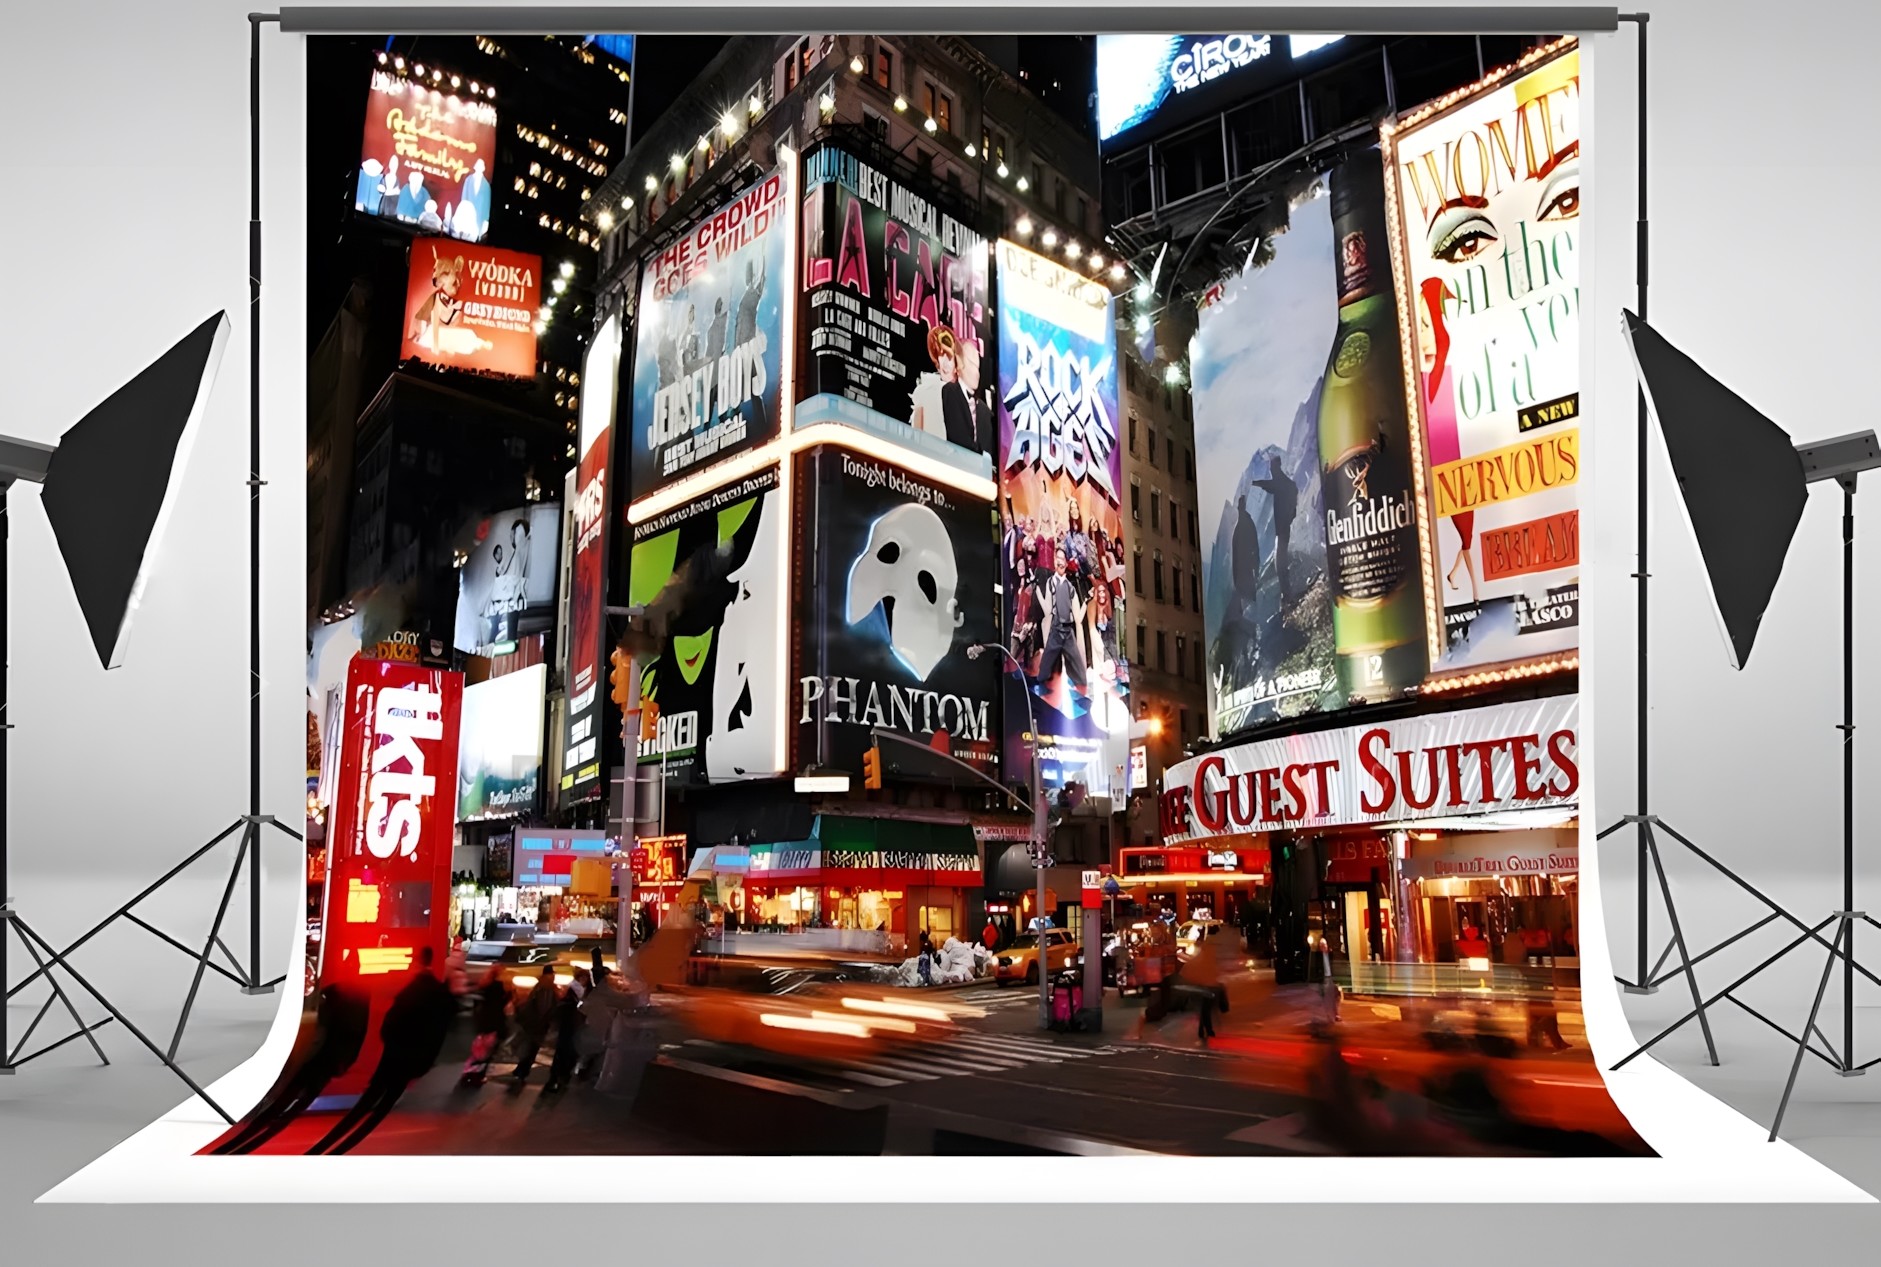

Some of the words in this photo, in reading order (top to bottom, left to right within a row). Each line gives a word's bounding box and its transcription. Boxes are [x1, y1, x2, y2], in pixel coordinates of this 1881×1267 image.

[1401, 76, 1579, 223] WOME
[859, 162, 888, 211] BEST
[648, 235, 691, 280] THE
[697, 174, 780, 251] CROWD
[468, 256, 533, 288] WÓDKA
[718, 330, 768, 418] BOYS
[1003, 325, 1117, 450] ROCK
[1519, 414, 1533, 430] A
[1537, 400, 1575, 424] NEW
[1438, 436, 1577, 514] NERVOUS
[1327, 489, 1416, 546] Glenfiddich
[637, 710, 698, 757] CKED
[800, 675, 990, 742] PHANTOM
[1193, 757, 1340, 832] GUEST
[1361, 729, 1579, 813] SUITES
